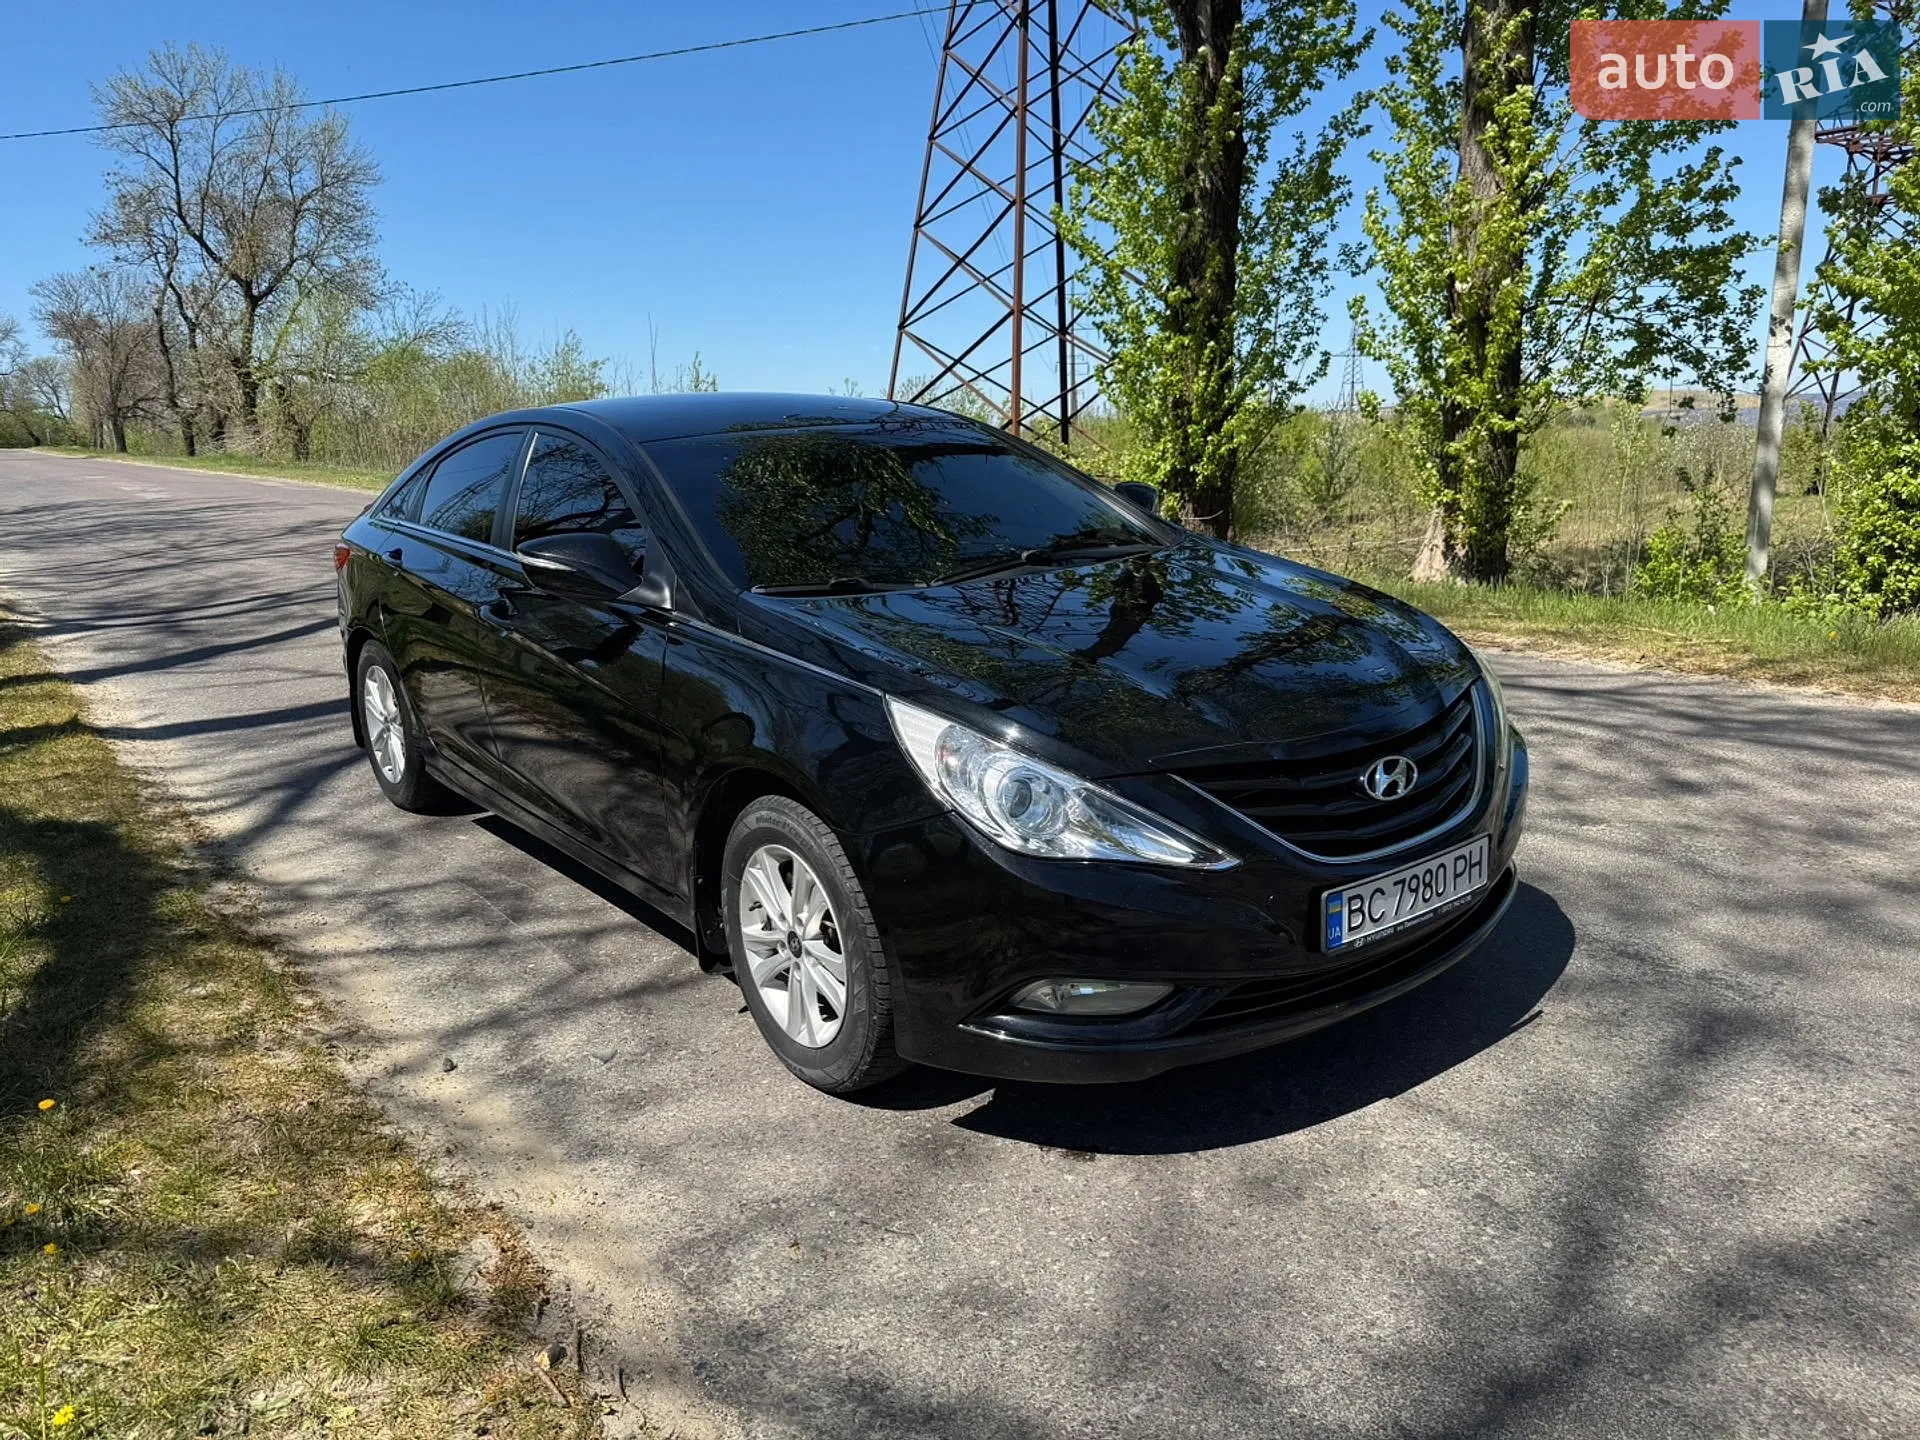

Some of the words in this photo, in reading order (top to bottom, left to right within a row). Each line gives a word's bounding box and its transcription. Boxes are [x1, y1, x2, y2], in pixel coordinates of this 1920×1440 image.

[1347, 887, 1386, 933] BC
[1393, 863, 1447, 916] 7980
[1453, 845, 1484, 891] PH
[1328, 926, 1342, 940] UA
